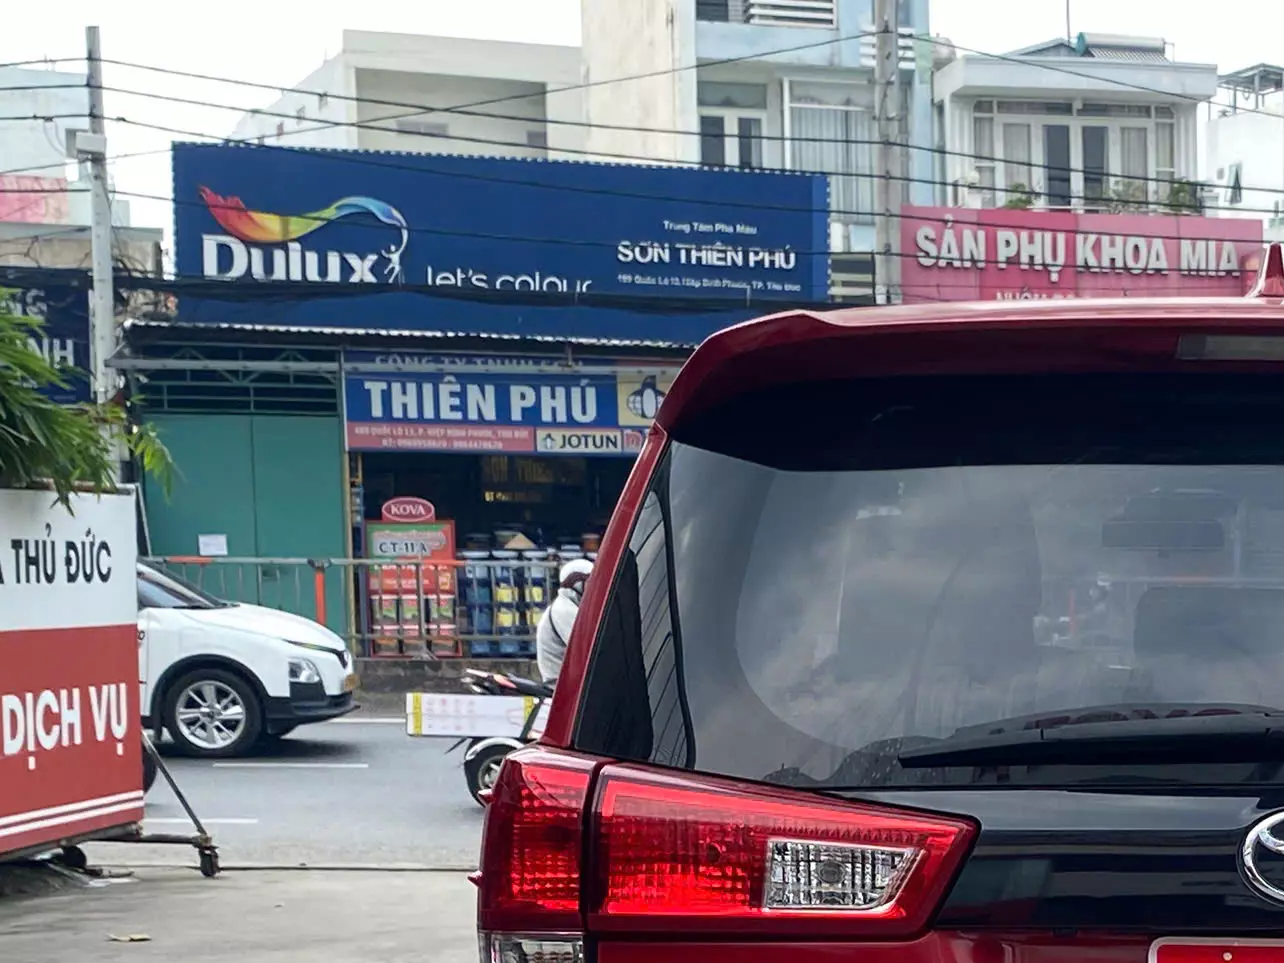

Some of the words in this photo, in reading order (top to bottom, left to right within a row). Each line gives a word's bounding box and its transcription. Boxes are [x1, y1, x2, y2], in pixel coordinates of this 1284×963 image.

[201, 233, 379, 284] Dulux
[748, 244, 796, 270] PHÚ
[915, 213, 986, 269] SẢN
[997, 231, 1066, 282] PHỤ
[1075, 233, 1169, 275] KHOA
[1180, 239, 1240, 277] MIA
[364, 375, 497, 421] THIÊN
[509, 378, 598, 424] PHÚ
[560, 433, 618, 449] JOTUN
[391, 503, 427, 516] KOVA
[11, 523, 56, 585] THỦ
[65, 527, 112, 583] ĐỨC
[2, 688, 82, 771] DỊCH
[88, 682, 128, 756] VỤ
